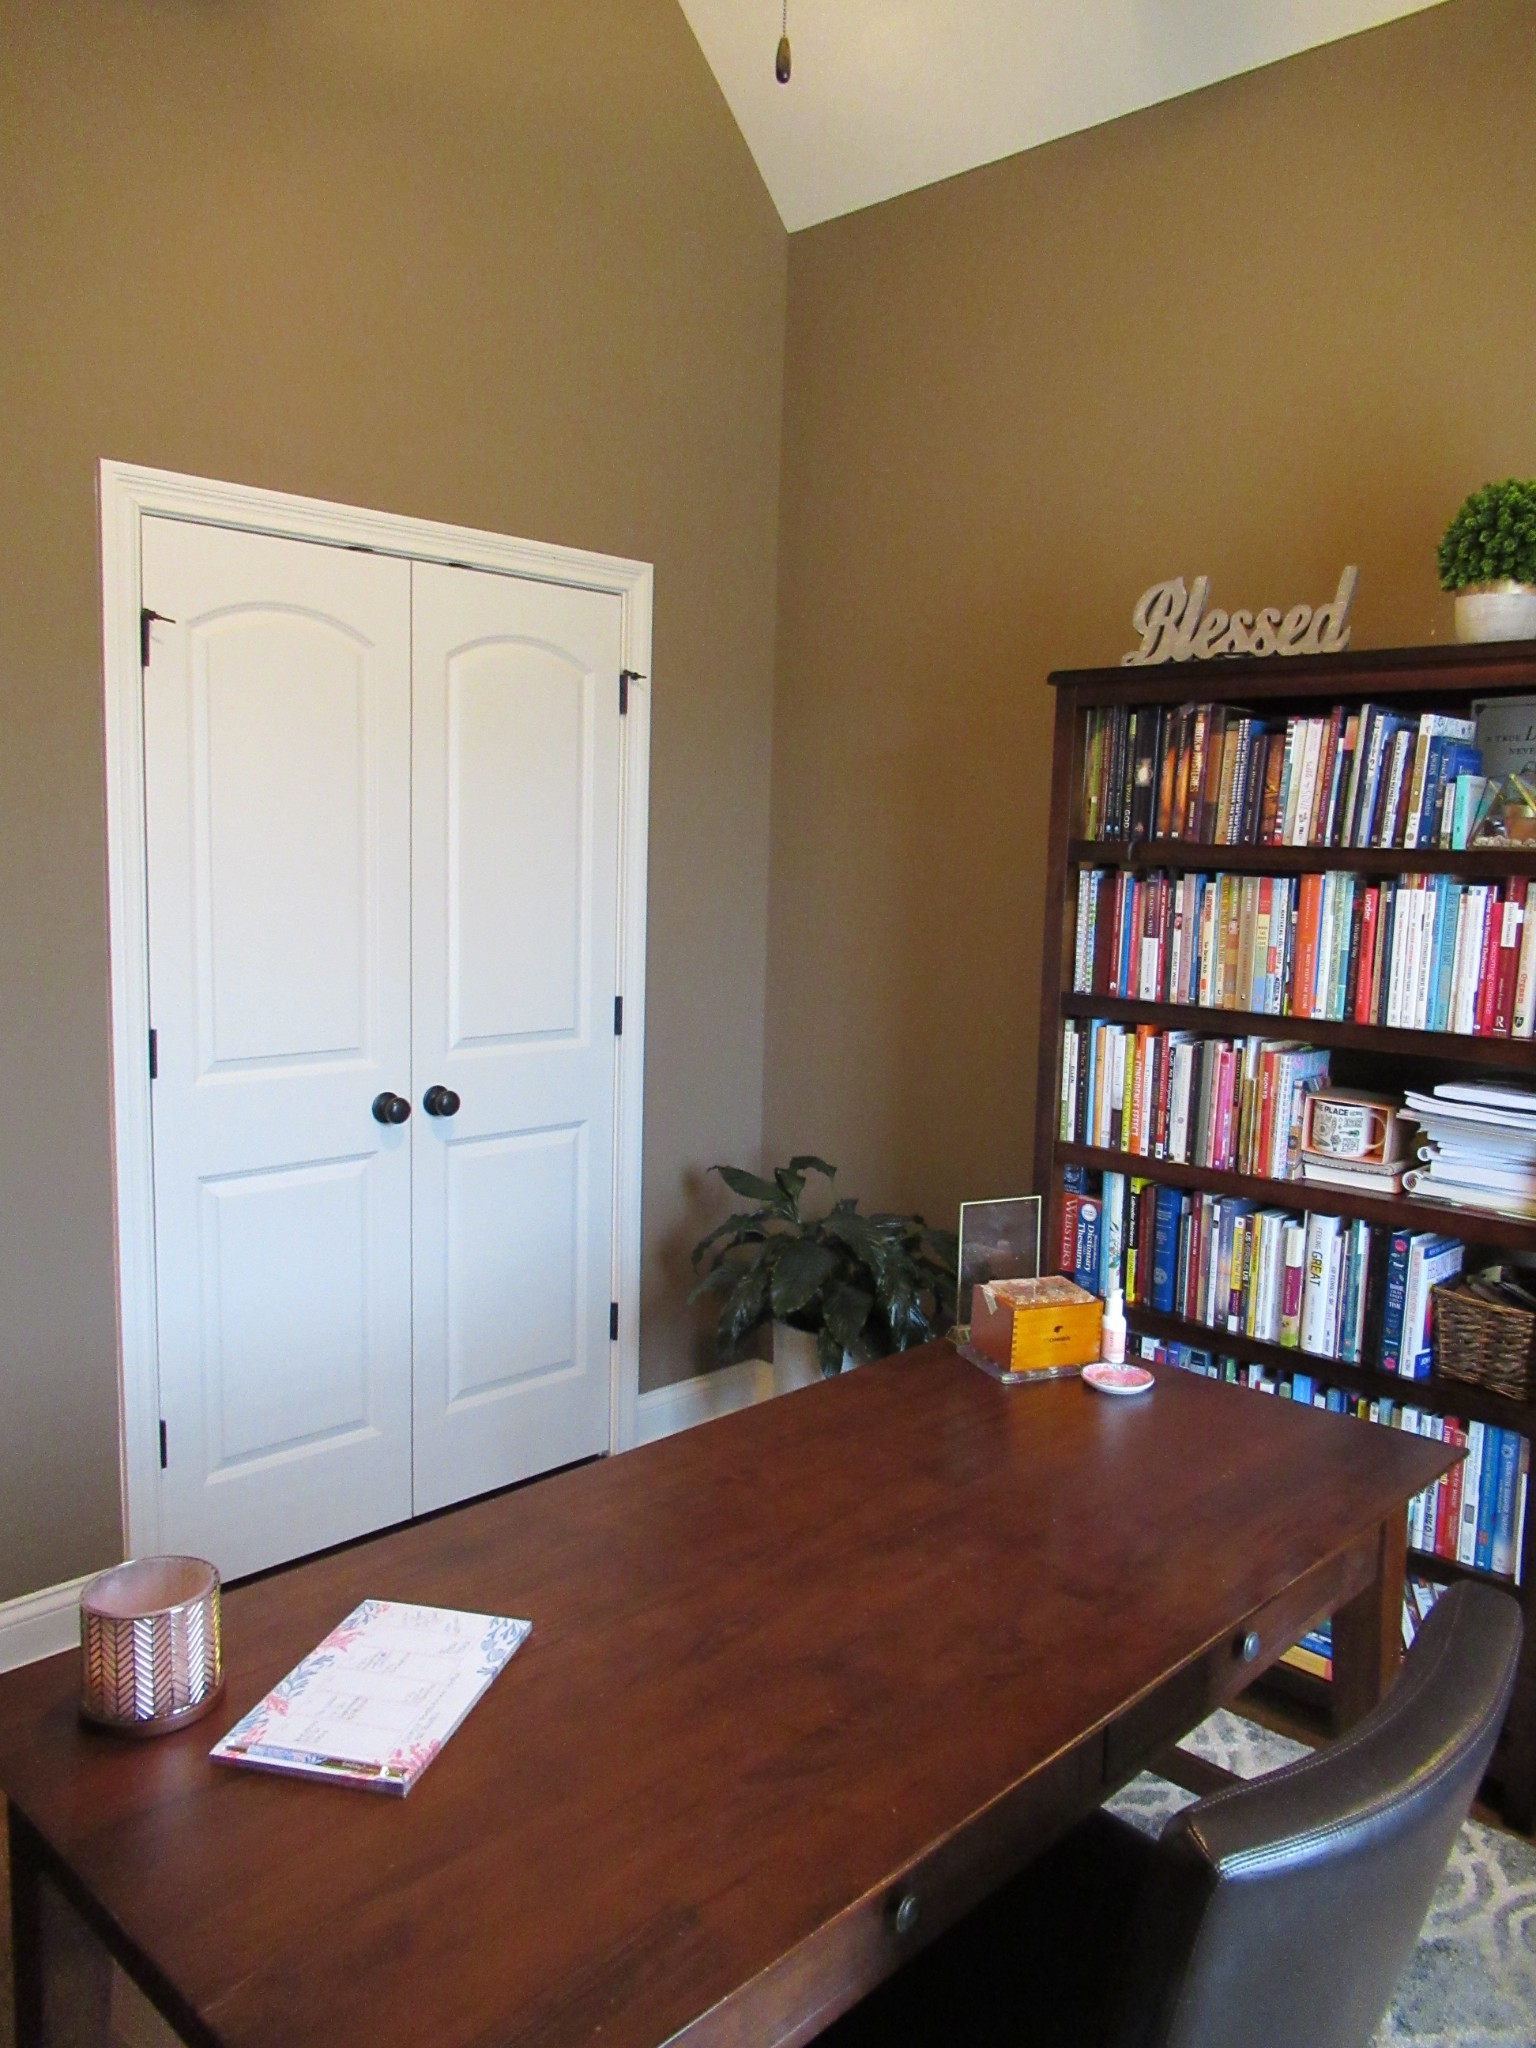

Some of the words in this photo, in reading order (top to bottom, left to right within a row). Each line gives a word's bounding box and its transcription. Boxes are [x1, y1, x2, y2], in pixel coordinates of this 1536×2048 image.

[1121, 565, 1359, 667] Blessed
[1189, 752, 1203, 792] MYSTERIES
[1364, 894, 1372, 921] under
[1487, 941, 1498, 981] becoming
[1517, 973, 1528, 1004] Orgasm
[1132, 1060, 1142, 1108] CONFIDENCE
[1131, 1109, 1139, 1136] EFFECT
[1325, 1106, 1349, 1116] PLACE
[1063, 1199, 1078, 1266] WEBSTER'S
[1076, 1223, 1085, 1269] Thesaurus
[1084, 1224, 1095, 1273] Dictionary
[1245, 1231, 1251, 1242] US
[1314, 1227, 1323, 1250] FEELING
[1243, 1271, 1248, 1281] US
[1309, 1251, 1323, 1287] GREAT
